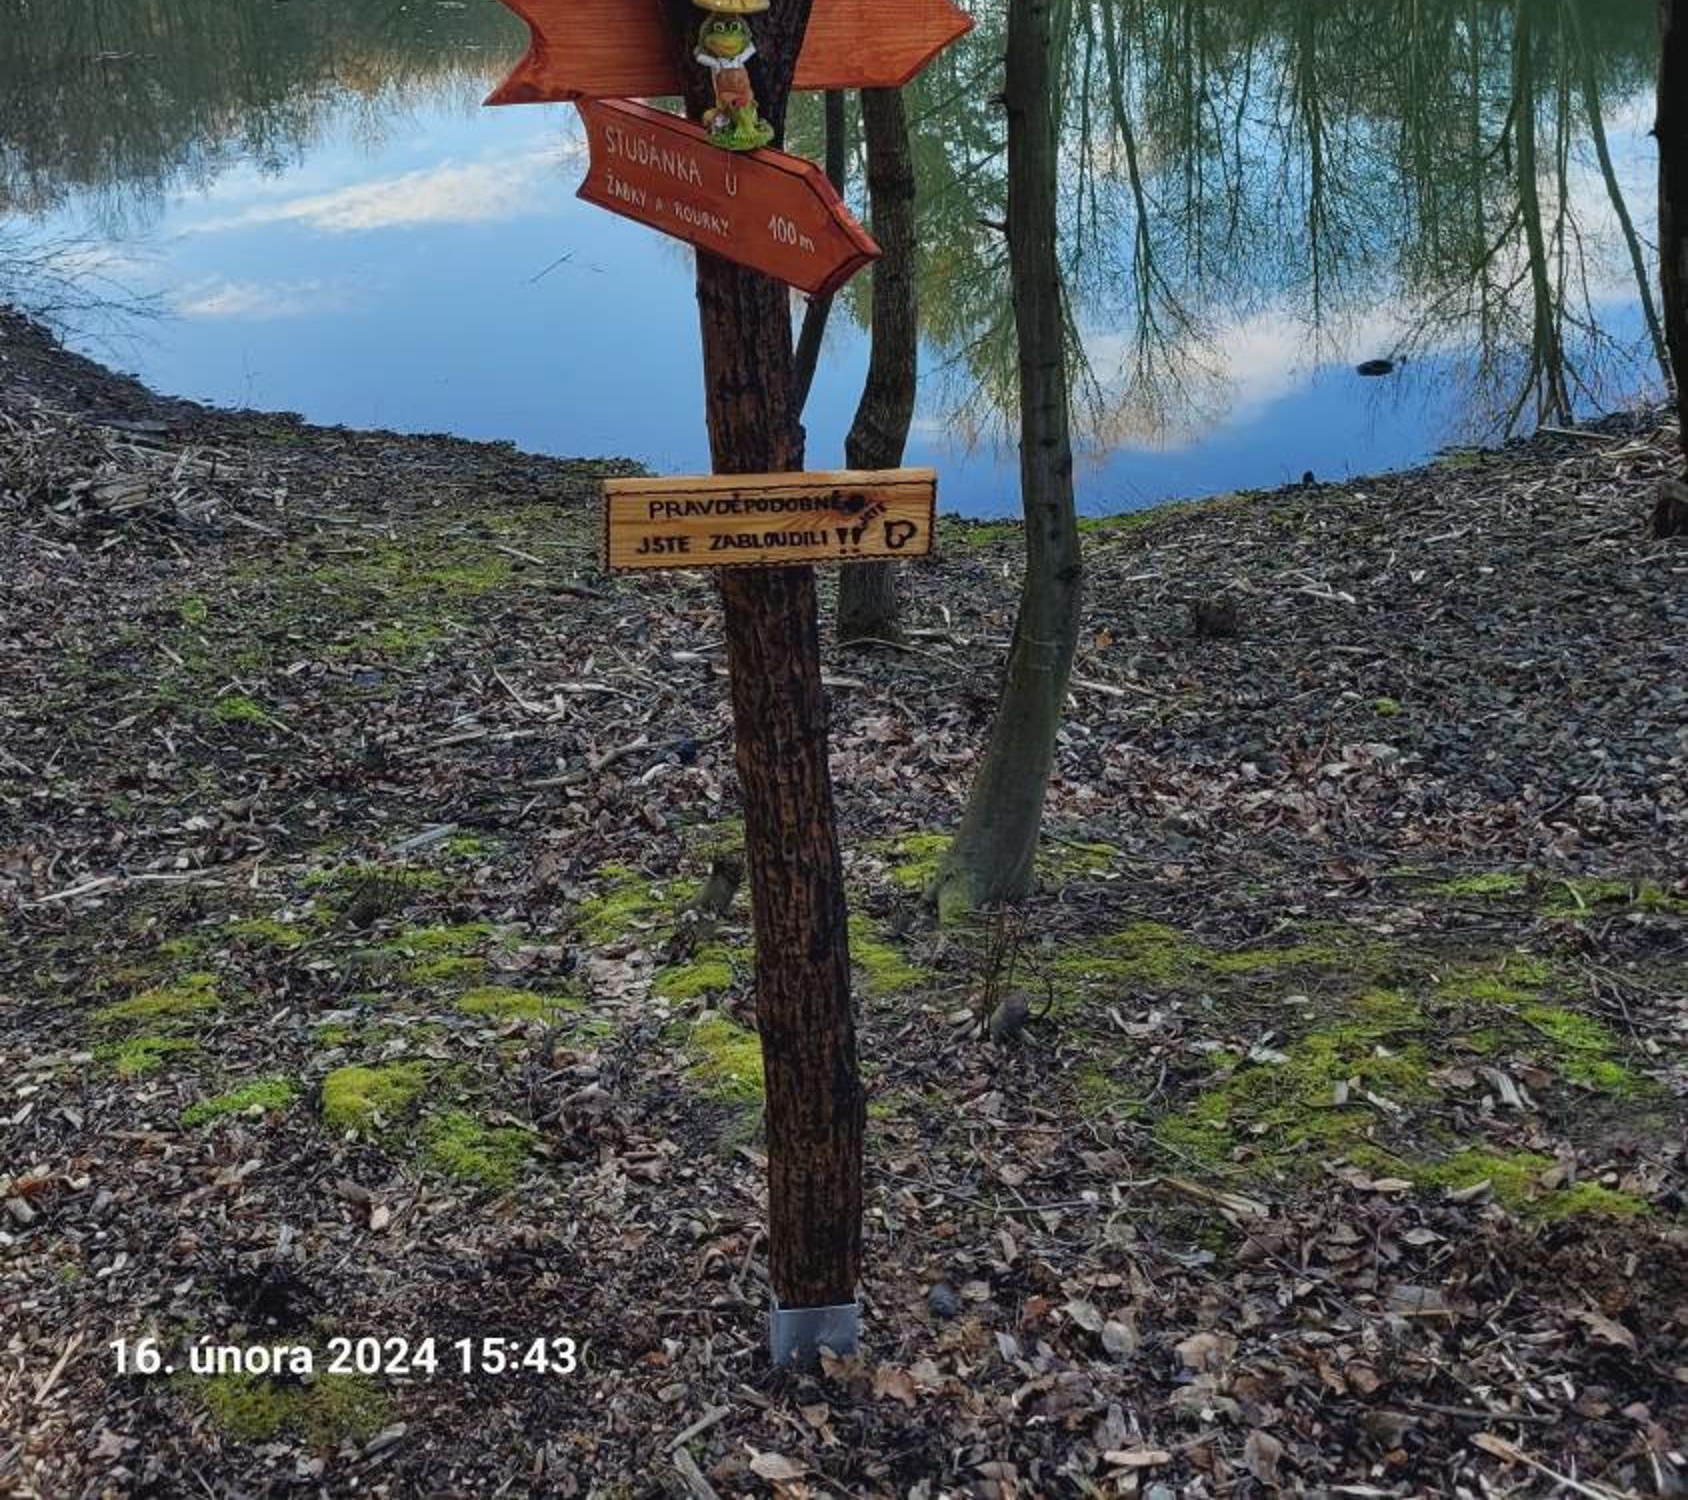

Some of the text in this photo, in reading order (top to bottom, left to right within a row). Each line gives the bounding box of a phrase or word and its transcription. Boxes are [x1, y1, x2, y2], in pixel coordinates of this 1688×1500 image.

[604, 125, 738, 197] STUDÁNKA U
[636, 535, 690, 555] JSTE
[708, 529, 828, 551] ZABLOUDILI
